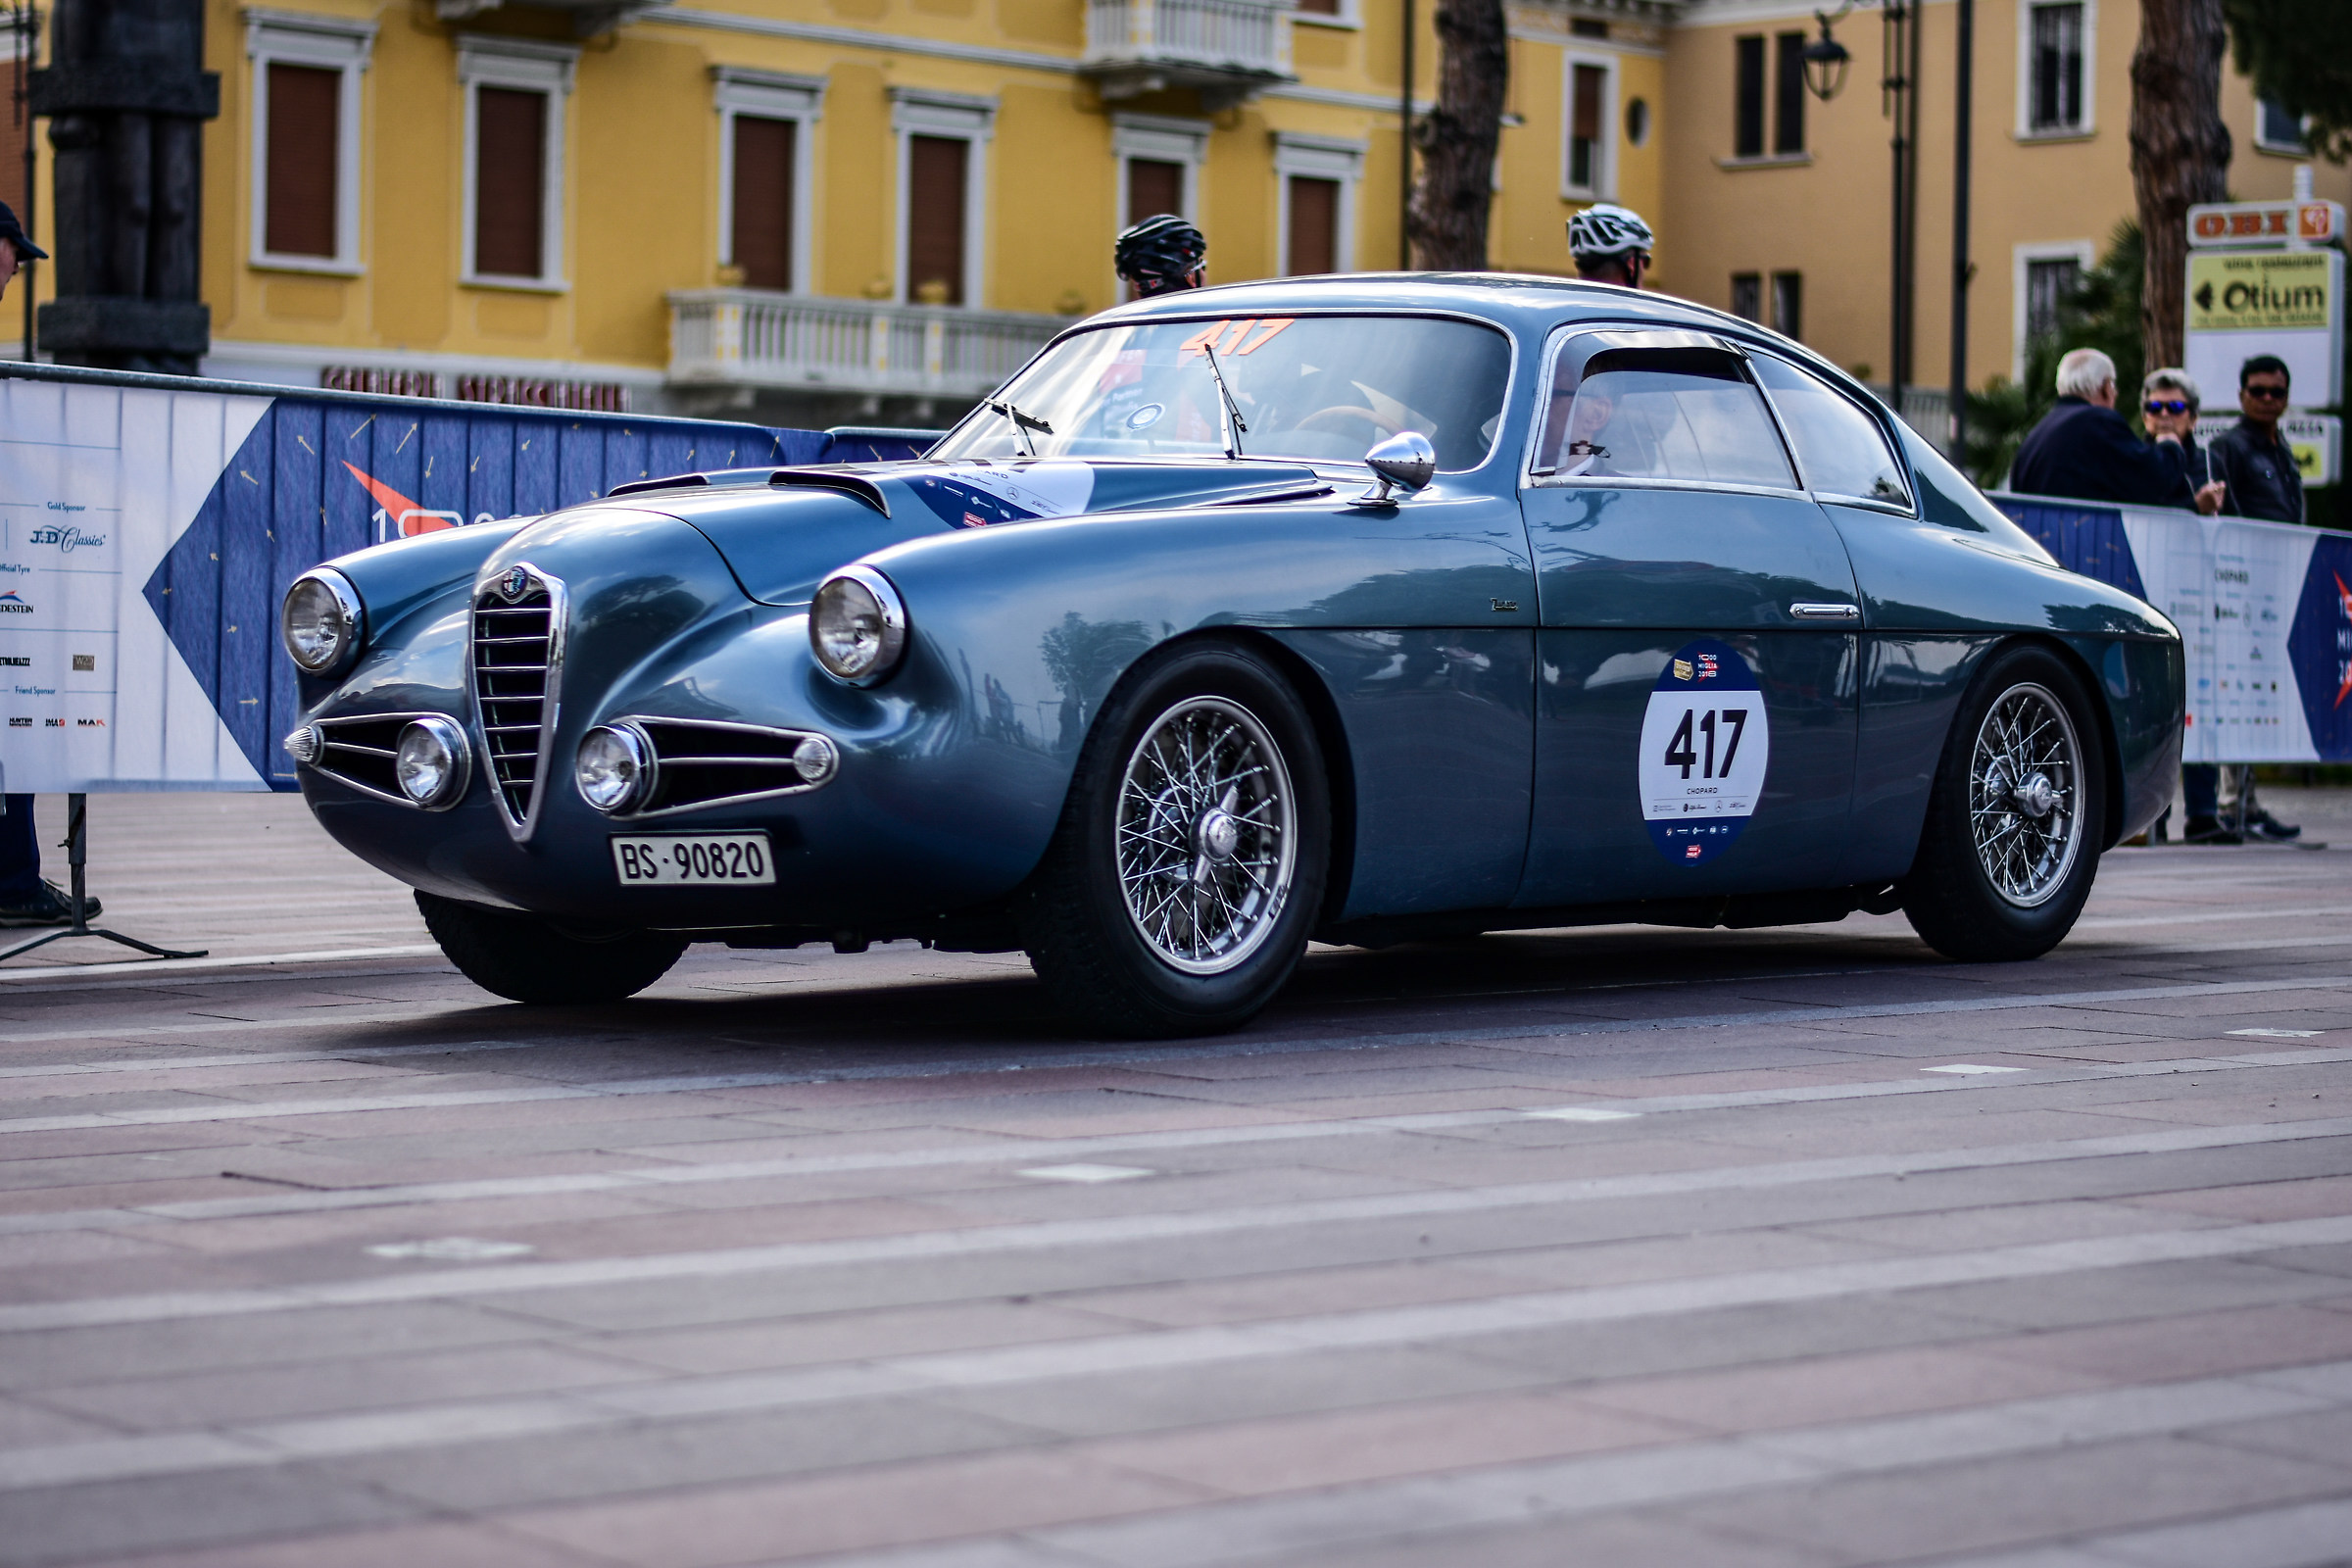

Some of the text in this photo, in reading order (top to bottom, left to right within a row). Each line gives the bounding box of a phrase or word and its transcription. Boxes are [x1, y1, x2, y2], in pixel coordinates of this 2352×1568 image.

[2194, 211, 2287, 239] OBI
[2223, 272, 2325, 314] Otium
[1179, 318, 1296, 358] 417
[47, 501, 86, 514] Gold Sponsor
[60, 525, 106, 554] Classics
[18, 564, 30, 575] Tyre
[15, 686, 56, 697] Friend Sponsor
[77, 718, 106, 727] MAK
[1665, 709, 1747, 779] 417
